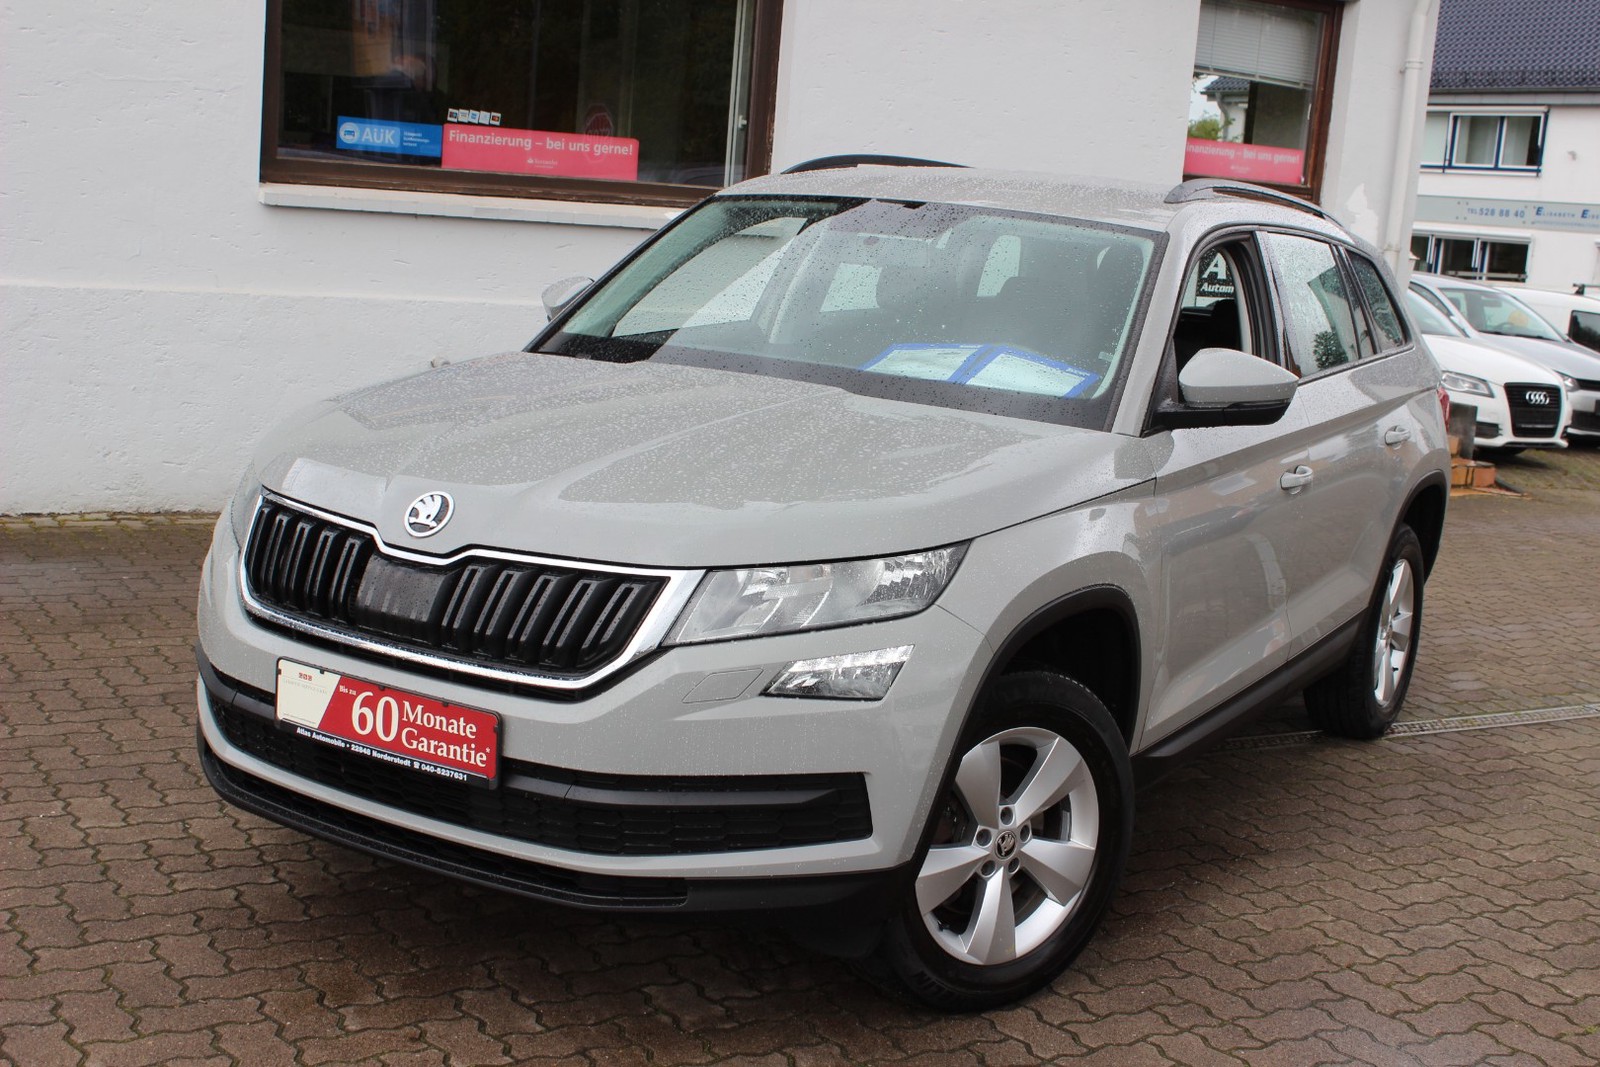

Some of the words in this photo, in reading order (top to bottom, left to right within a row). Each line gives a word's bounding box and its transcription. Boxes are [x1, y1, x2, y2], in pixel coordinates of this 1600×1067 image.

[448, 130, 532, 149] Finanzierung
[546, 137, 565, 151] bei
[568, 141, 590, 153] uns
[593, 141, 633, 156] gerne!
[1186, 143, 1235, 159] inanzierung
[1243, 148, 1257, 160] bei
[1257, 151, 1272, 160] uns
[339, 685, 349, 694] Bis
[352, 691, 399, 742] 60
[402, 700, 477, 739] Monate
[296, 727, 311, 737] Atlas
[311, 732, 346, 748] Automobile
[372, 749, 411, 767] Norderstedt
